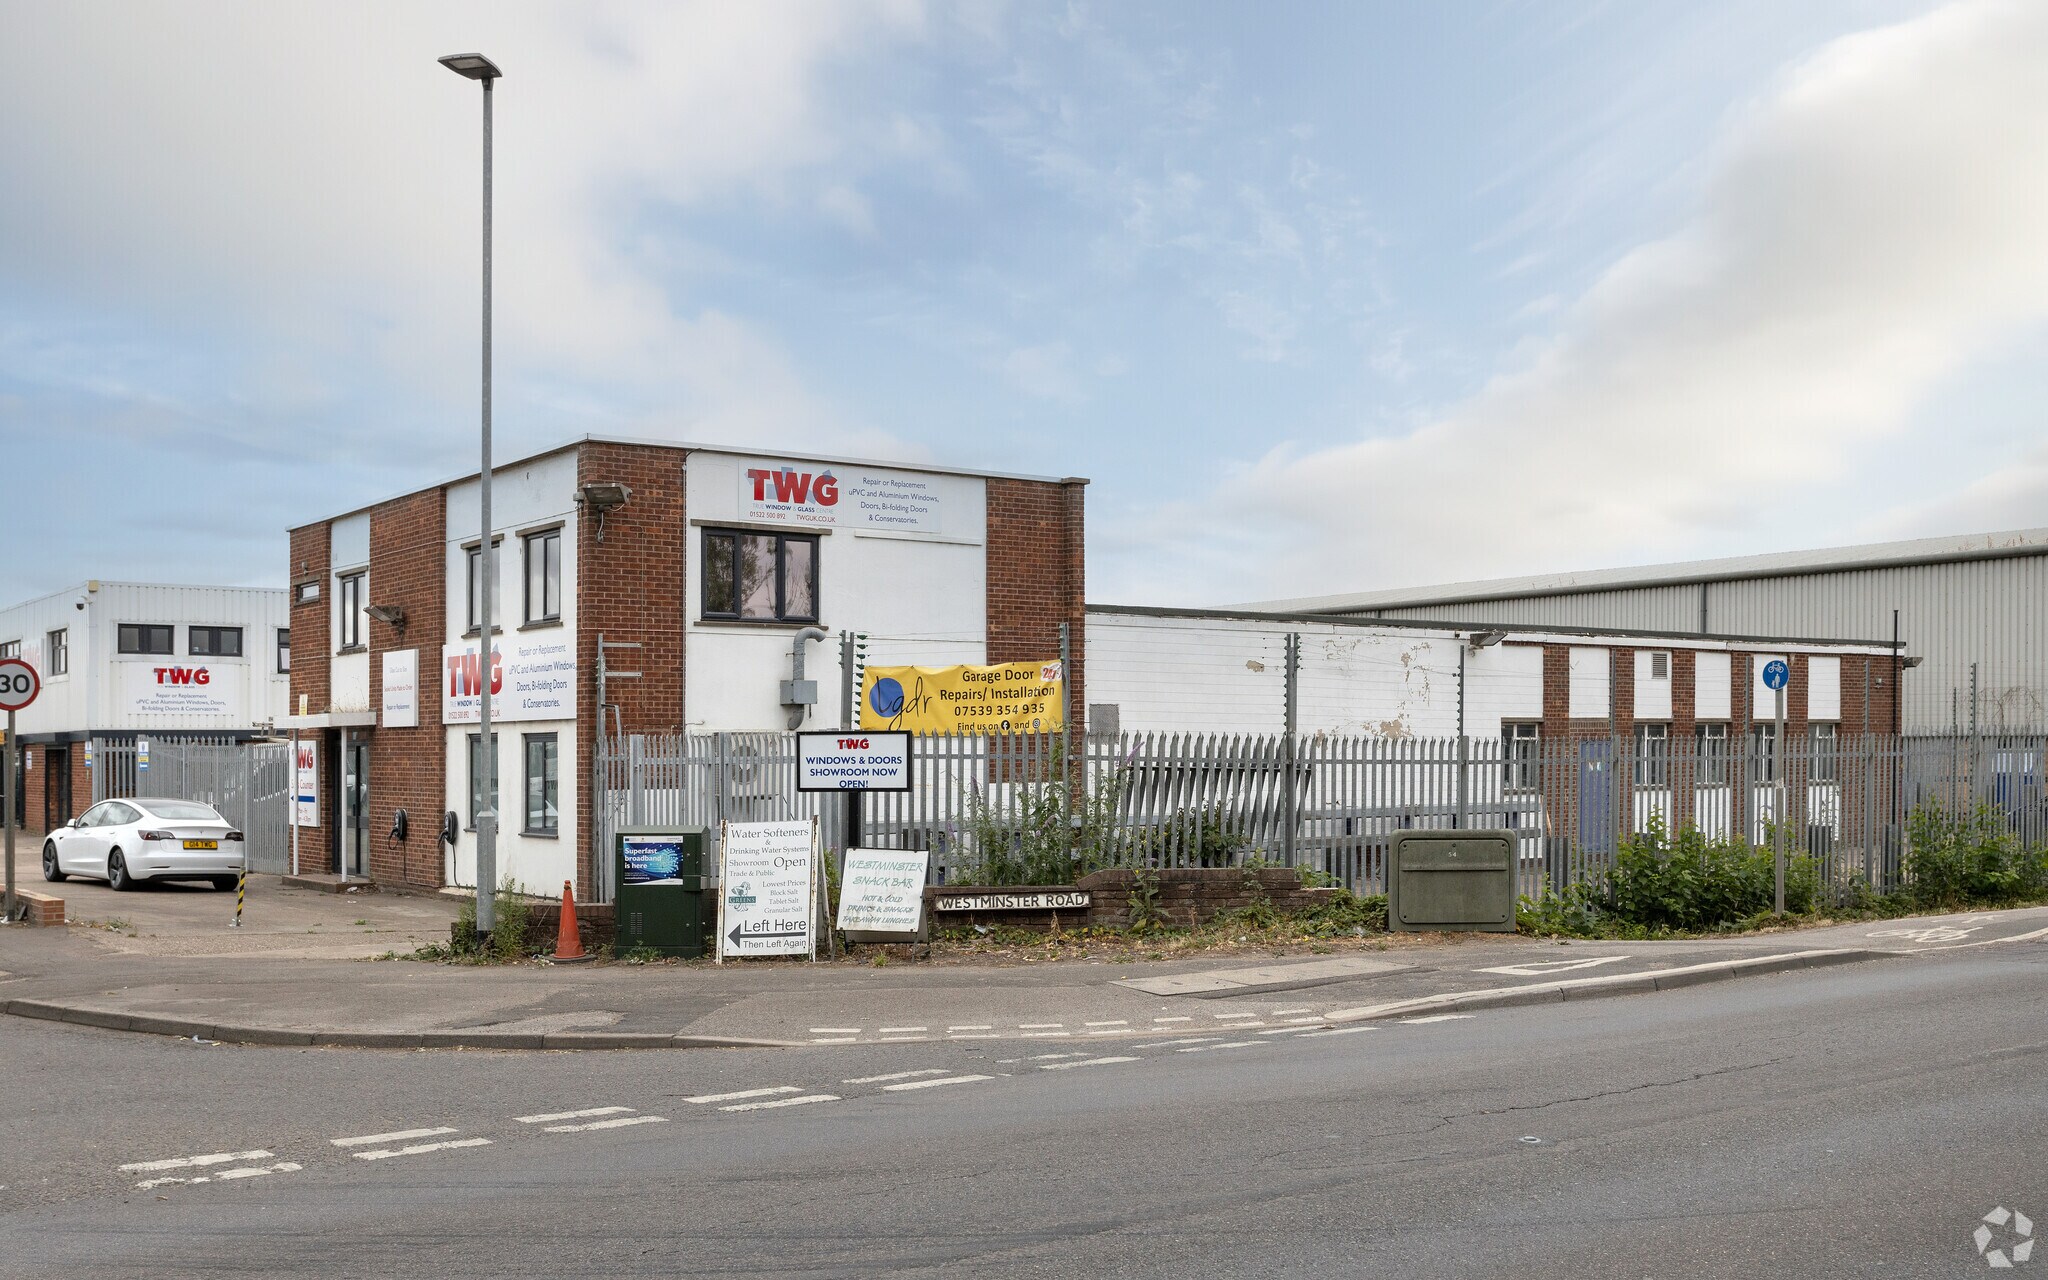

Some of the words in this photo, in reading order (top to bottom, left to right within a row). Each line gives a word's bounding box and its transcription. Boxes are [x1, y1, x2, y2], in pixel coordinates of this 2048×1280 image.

[748, 469, 838, 507] TWG
[862, 477, 880, 486] Repair
[890, 480, 926, 489] Replacement
[848, 488, 865, 496] uPVC
[878, 491, 909, 499] Aluminium
[911, 493, 939, 502] Windows,
[860, 501, 880, 510] Doors,
[882, 503, 909, 513] Bi-folding
[874, 514, 918, 524] Conservatories.
[519, 646, 531, 658] Repair
[539, 644, 566, 658] Replacement
[448, 651, 502, 697] TWG
[509, 664, 520, 675] uPVC
[529, 662, 552, 673] Aluminium
[153, 668, 210, 685] TWG
[962, 670, 1001, 684] Garage
[1005, 668, 1034, 680] Door
[0, 674, 30, 693] 30
[516, 682, 531, 693] Doors,
[532, 682, 552, 692] Bi-folding
[553, 679, 567, 689] Doors
[940, 687, 988, 701] Repairs/
[991, 685, 1055, 699] Installation
[522, 699, 526, 708] &
[527, 698, 560, 708] Conservatories.
[954, 706, 993, 717] 07539
[996, 704, 1018, 714] 354
[1022, 702, 1045, 713] 935
[957, 722, 974, 731] Find
[1014, 721, 1029, 729] and
[837, 739, 870, 750] TWG
[806, 756, 856, 764] WINDOWS
[810, 768, 869, 776] SHOWROOM
[731, 829, 761, 839] Water
[763, 828, 809, 838] Softeners
[783, 846, 810, 854] Systems
[773, 856, 806, 870] Open
[848, 860, 923, 872] WESTMINSTER
[852, 876, 890, 887] SNACK
[891, 878, 914, 888] BAR
[885, 894, 903, 902] COLD
[942, 896, 1040, 909] WESTMINSTER
[1046, 894, 1085, 906] ROAD
[744, 920, 770, 932] Left
[775, 919, 806, 931] Here
[766, 940, 782, 948] Left
[784, 940, 806, 949] Again
